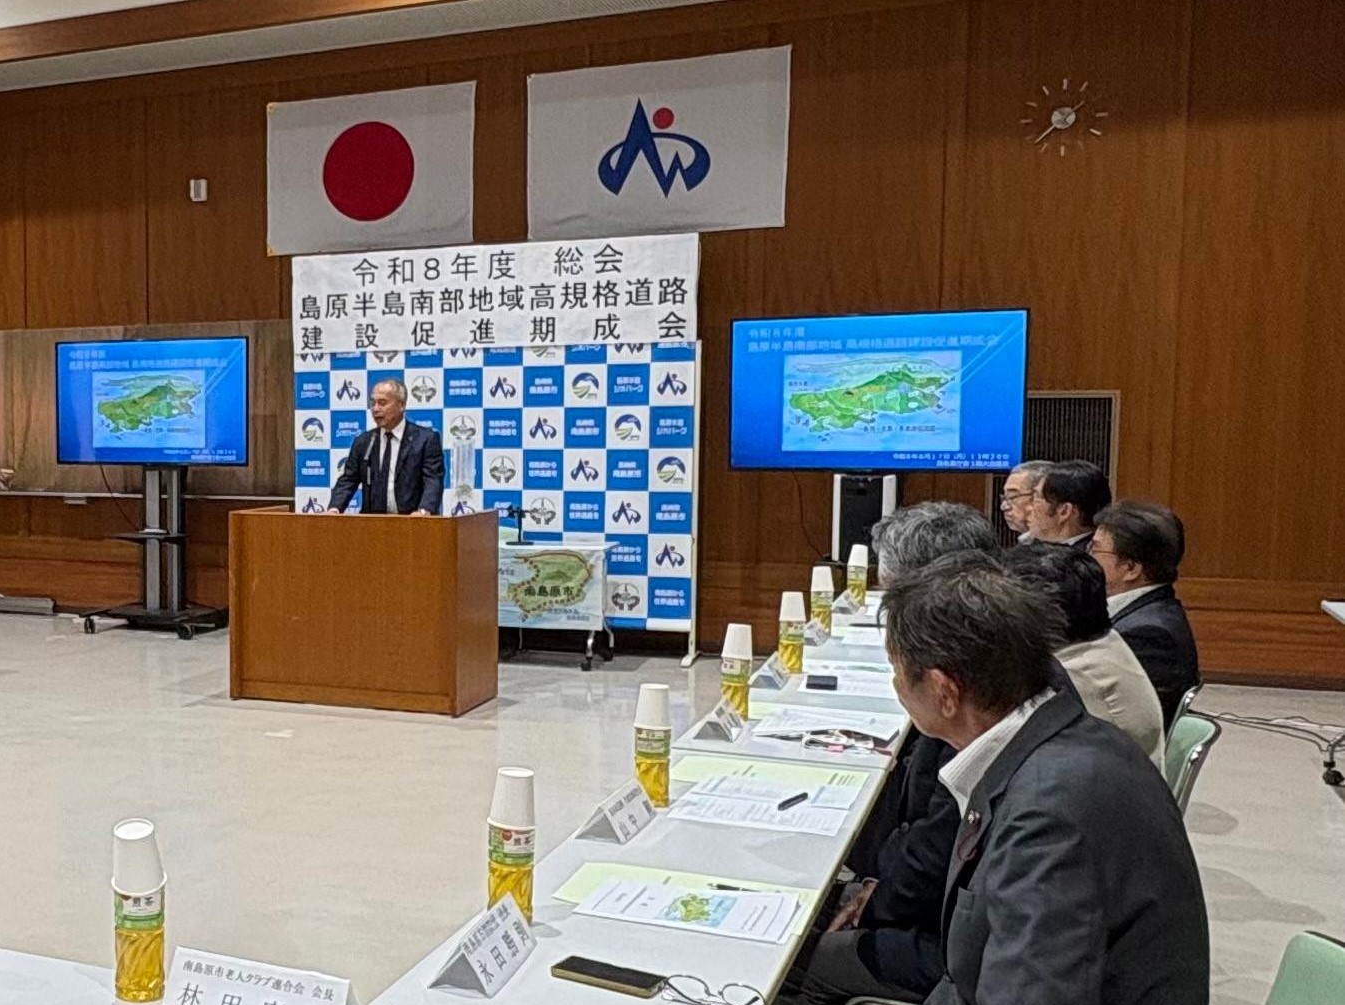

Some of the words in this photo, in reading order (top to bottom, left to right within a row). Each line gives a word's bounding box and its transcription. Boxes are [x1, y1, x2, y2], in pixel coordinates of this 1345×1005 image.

[353, 252, 516, 285] 令和8年度
[554, 244, 624, 276] 総会
[300, 276, 688, 319] 島原半島南部地域高規格道路
[302, 312, 687, 351] 建設促進期成会
[182, 960, 305, 996] 南島原市老人クラブ連合会
[312, 984, 335, 1002] 会長
